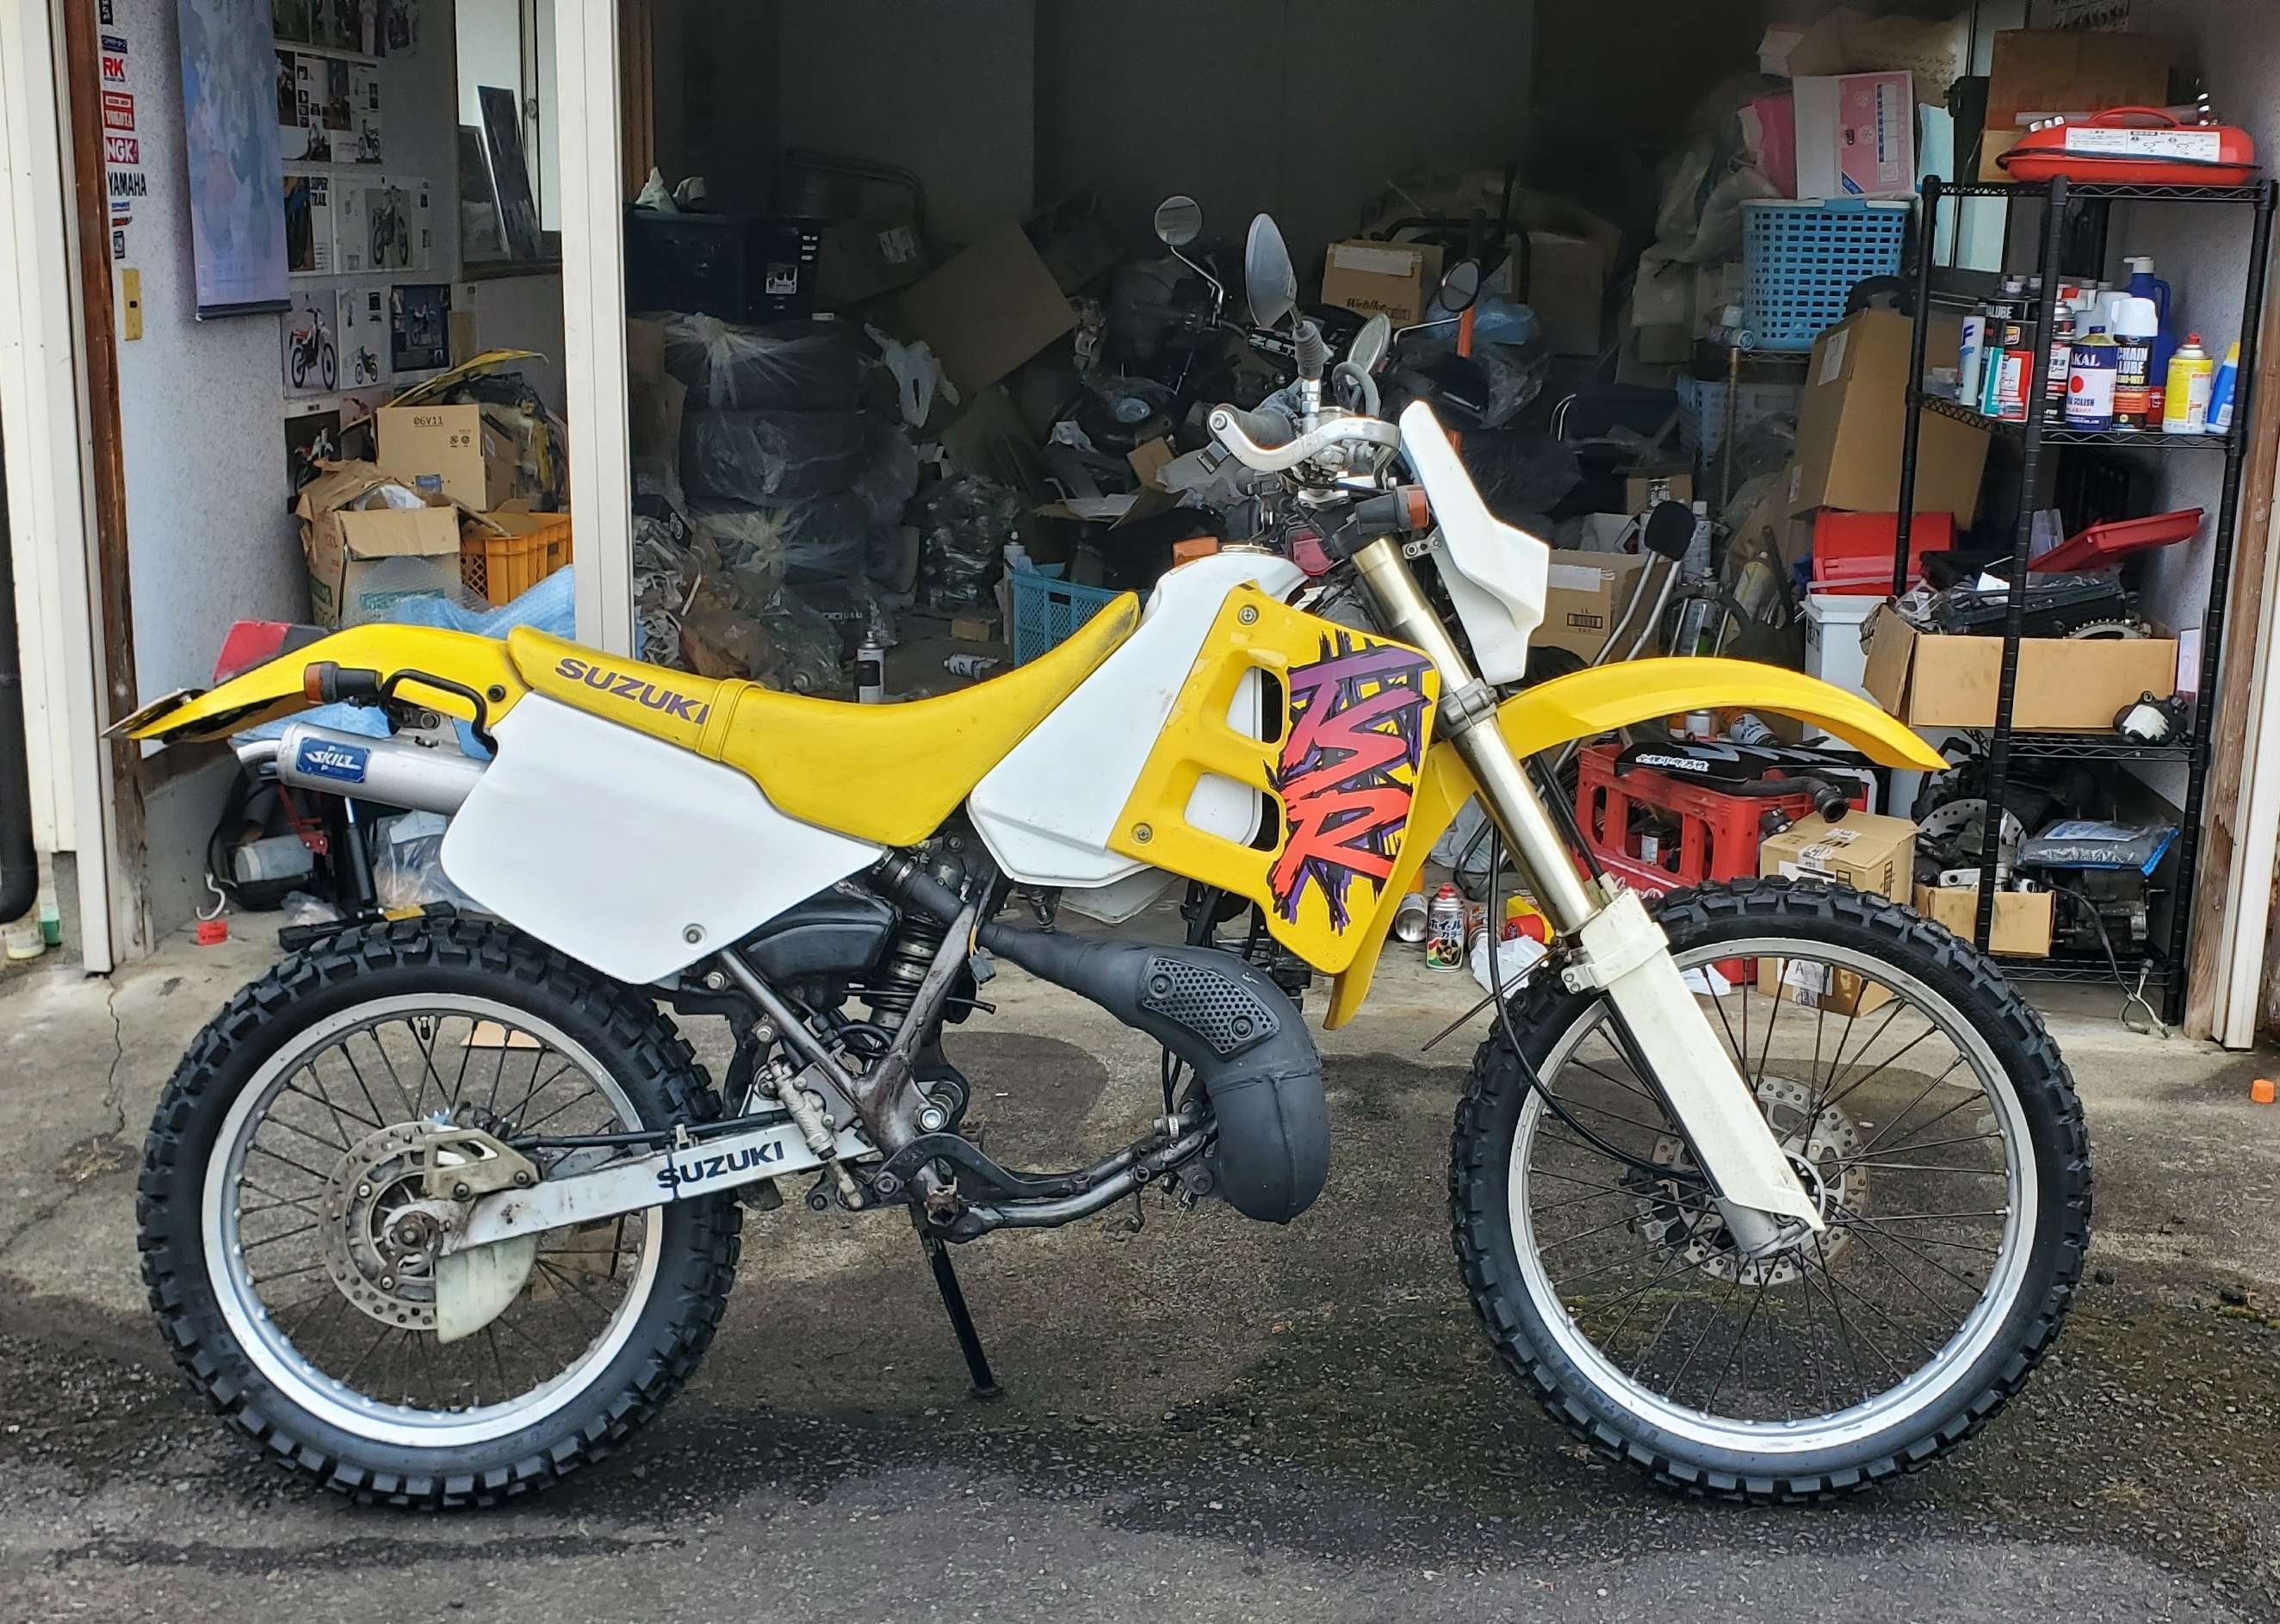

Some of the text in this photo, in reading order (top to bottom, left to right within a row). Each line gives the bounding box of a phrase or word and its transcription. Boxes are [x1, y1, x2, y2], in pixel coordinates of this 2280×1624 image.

[102, 57, 125, 78] RK
[106, 137, 134, 163] NGK
[108, 171, 147, 197] YAMAHA
[311, 177, 328, 190] SUPER
[2116, 347, 2148, 362] CHAIN
[2118, 361, 2144, 374] LUBE
[555, 658, 710, 725] SUZUKI
[1795, 961, 1804, 976] A
[656, 1140, 785, 1189] SUZUKI
